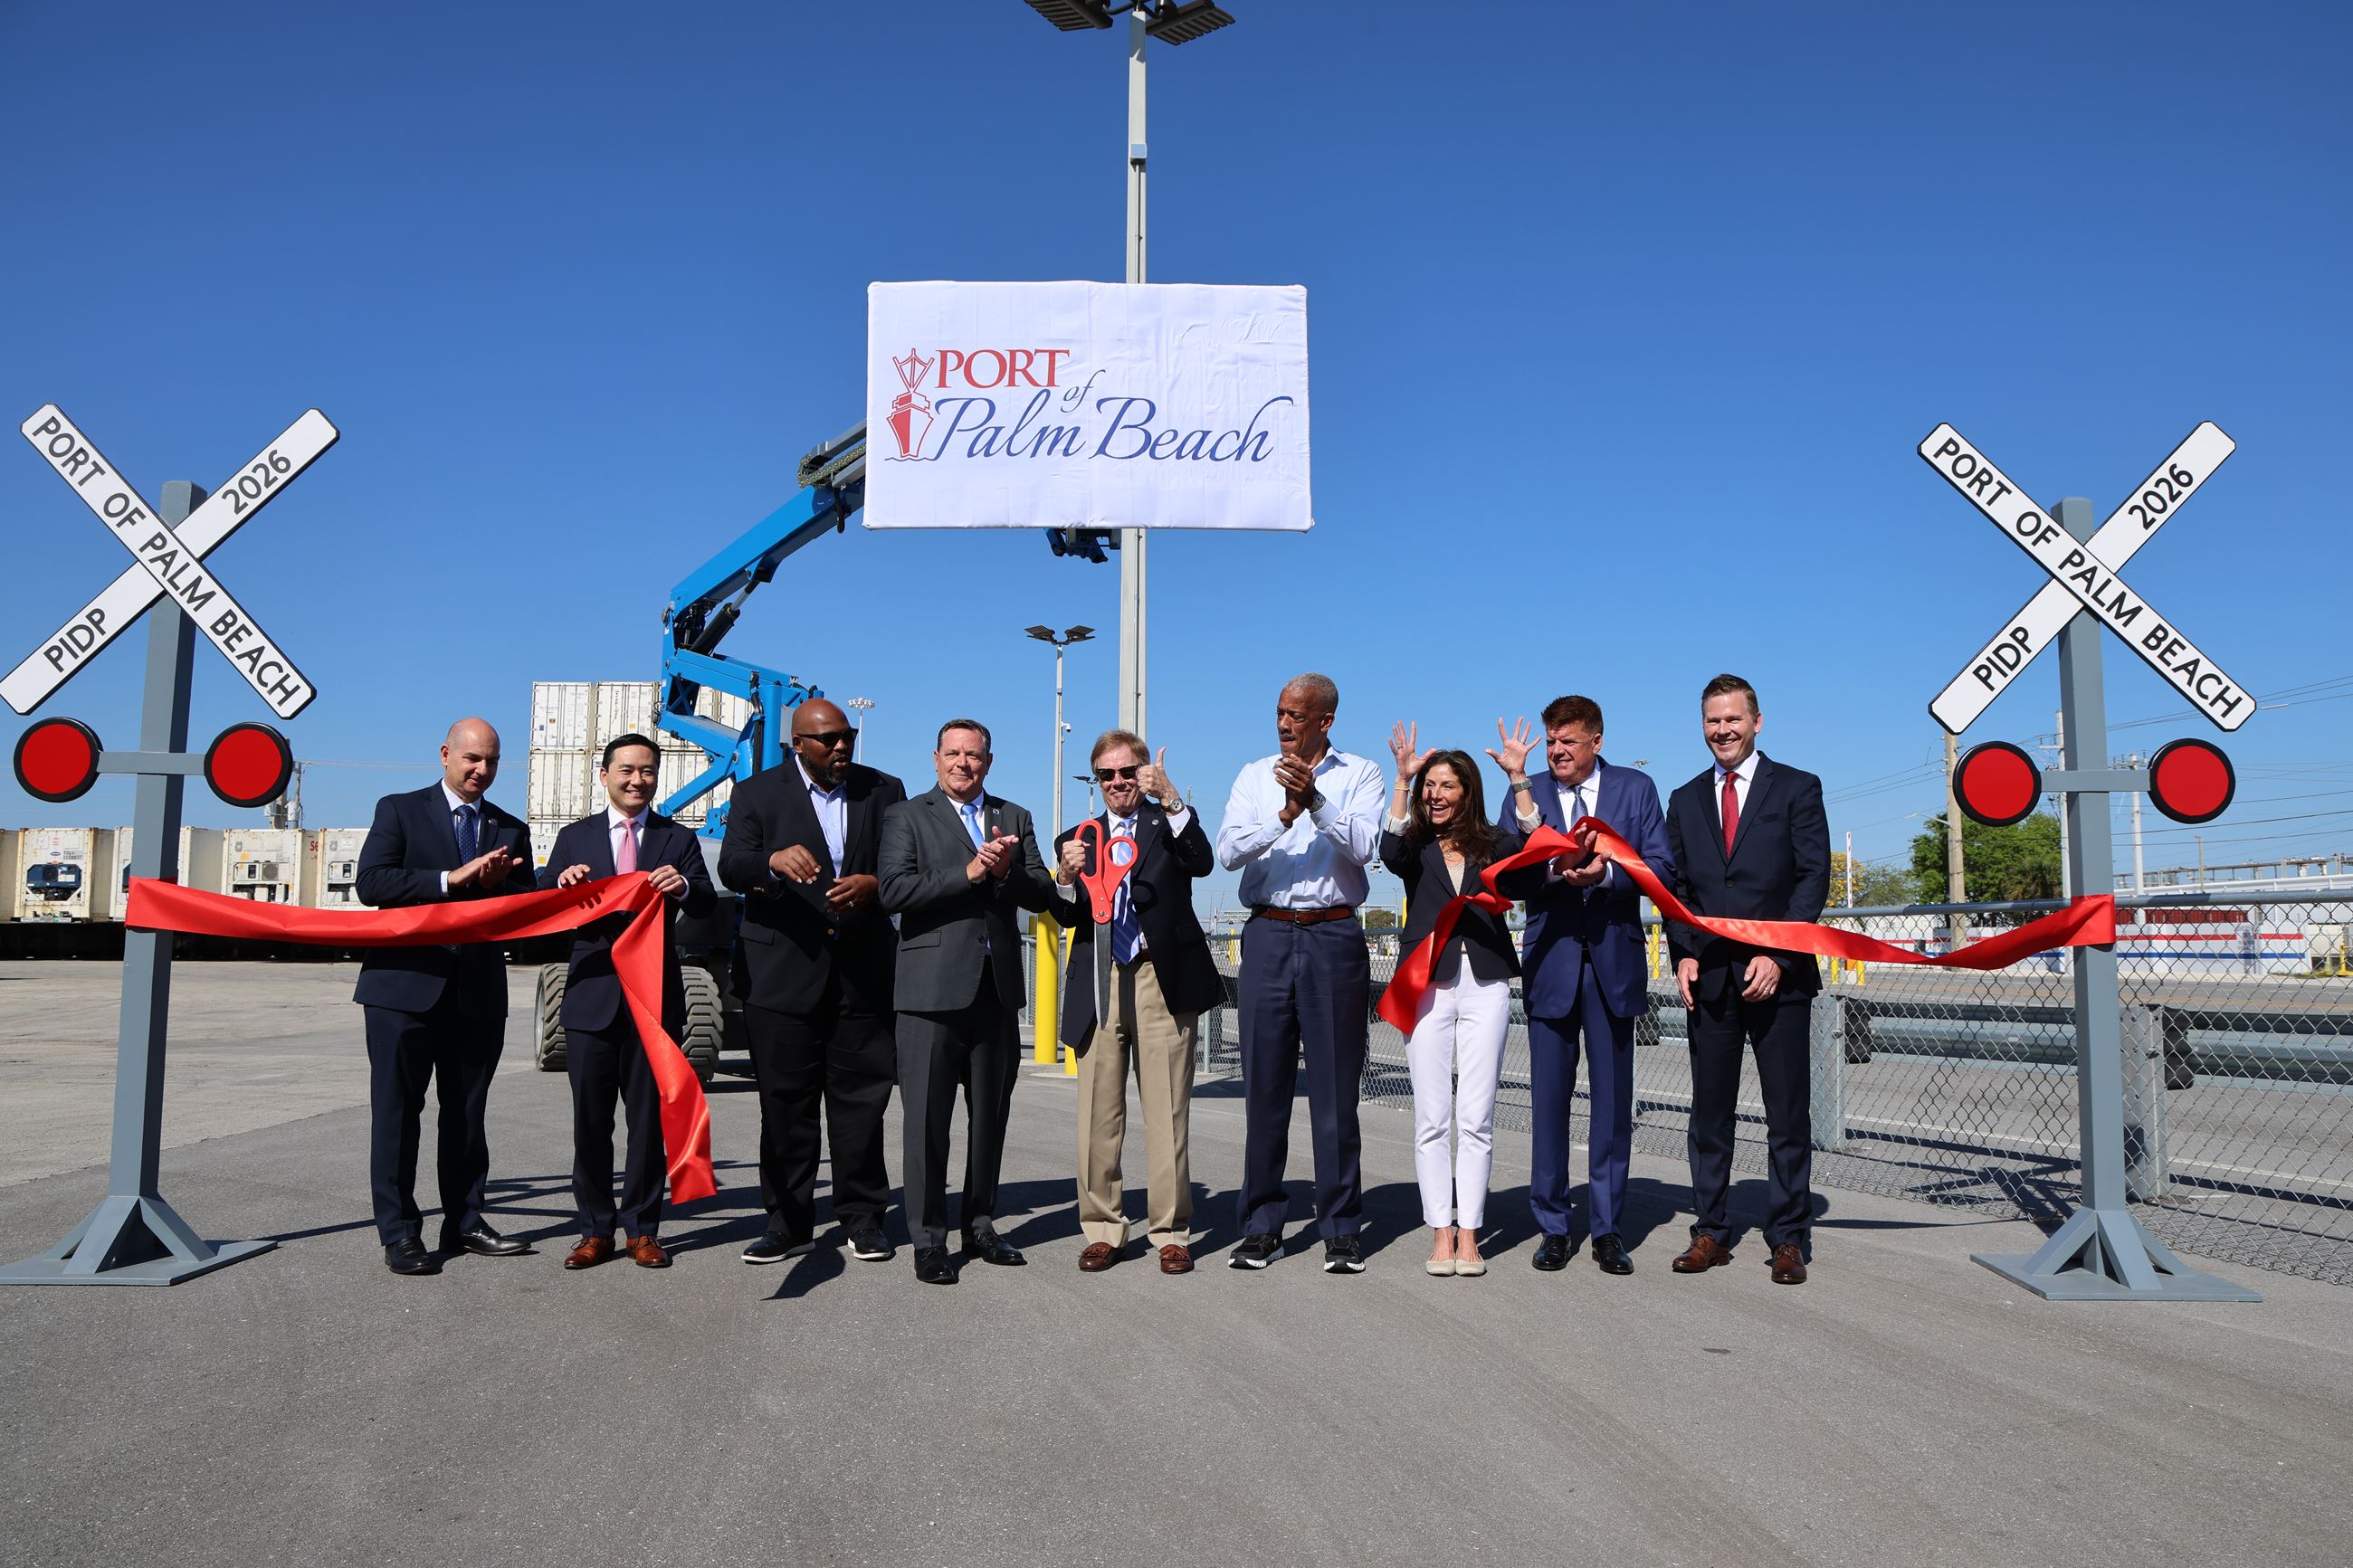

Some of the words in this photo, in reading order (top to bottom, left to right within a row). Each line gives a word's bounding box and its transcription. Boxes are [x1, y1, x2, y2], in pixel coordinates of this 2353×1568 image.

[935, 348, 1070, 389] PORT
[1060, 369, 1106, 413] of
[930, 388, 1086, 462] Palm
[1088, 395, 1294, 462] Beach
[221, 449, 291, 515] 2026
[2128, 462, 2194, 530] 2026
[32, 415, 106, 487] PORT
[103, 492, 147, 528] OF
[138, 531, 217, 613] PALM
[209, 608, 301, 708] BEACH
[1932, 436, 2013, 507] PORT
[2015, 510, 2061, 547] OF
[2057, 547, 2144, 628] PALM
[2140, 622, 2243, 718] BEACH
[43, 608, 107, 673] PIDP
[1971, 626, 2033, 692] PIDP
